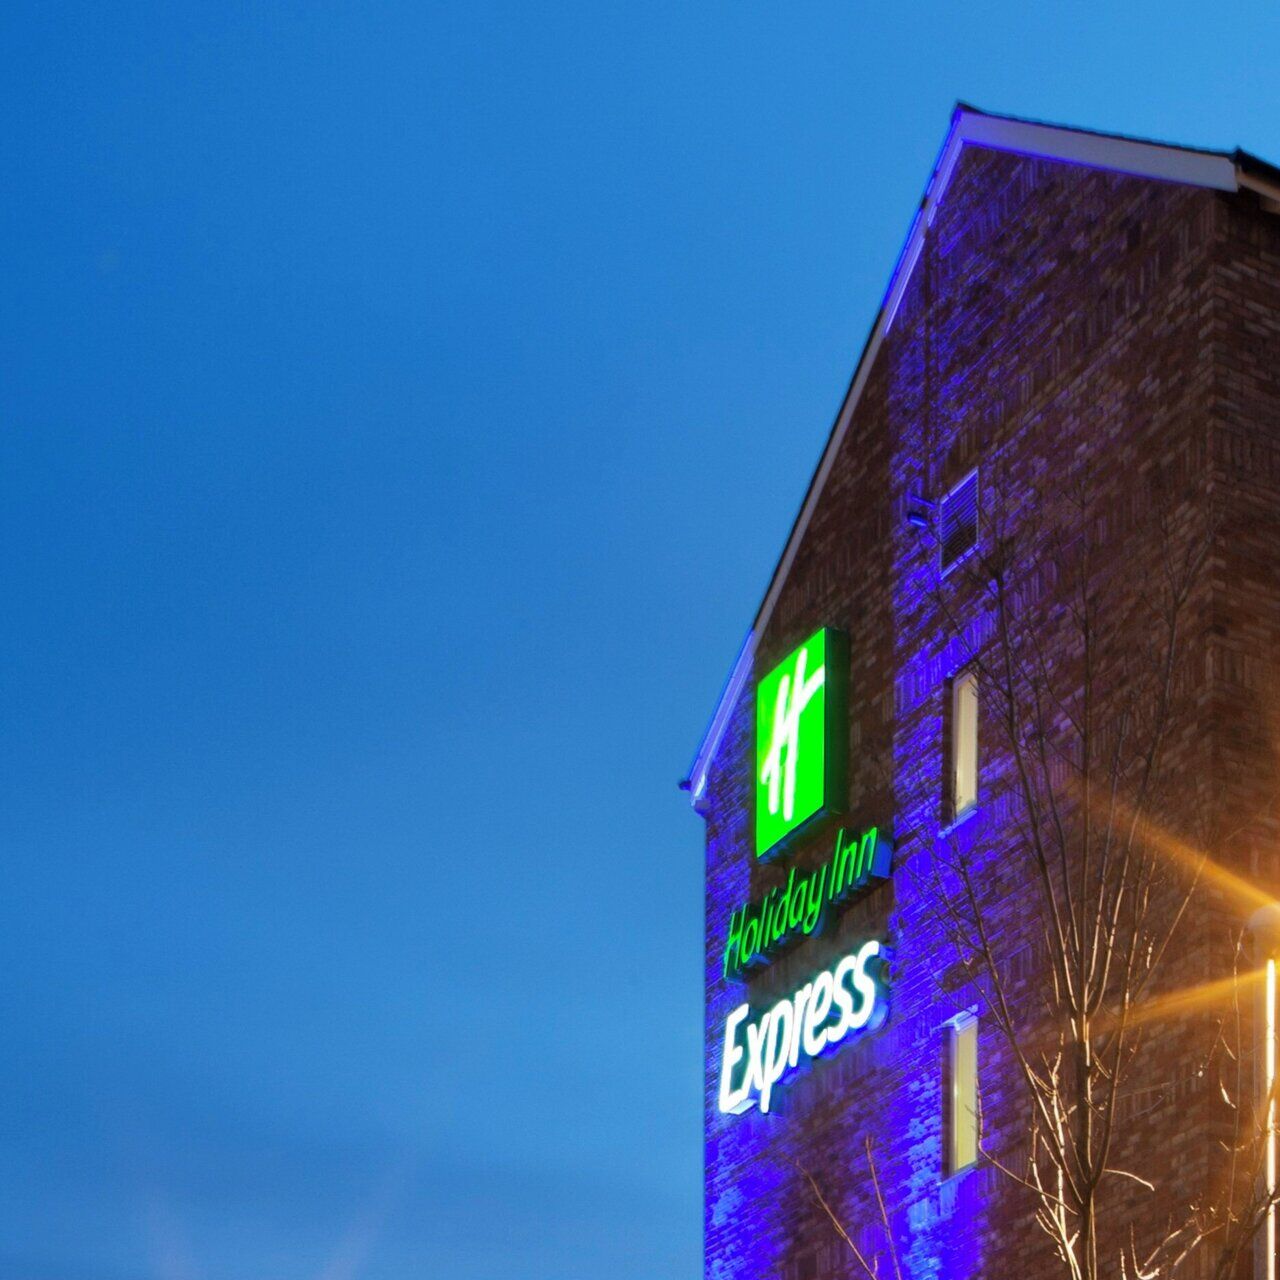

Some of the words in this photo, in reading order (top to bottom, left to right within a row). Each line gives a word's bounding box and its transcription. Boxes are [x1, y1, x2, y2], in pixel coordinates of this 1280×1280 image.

[724, 864, 828, 979] Holiday
[828, 826, 878, 900] Inn
[718, 940, 880, 1114] Express
